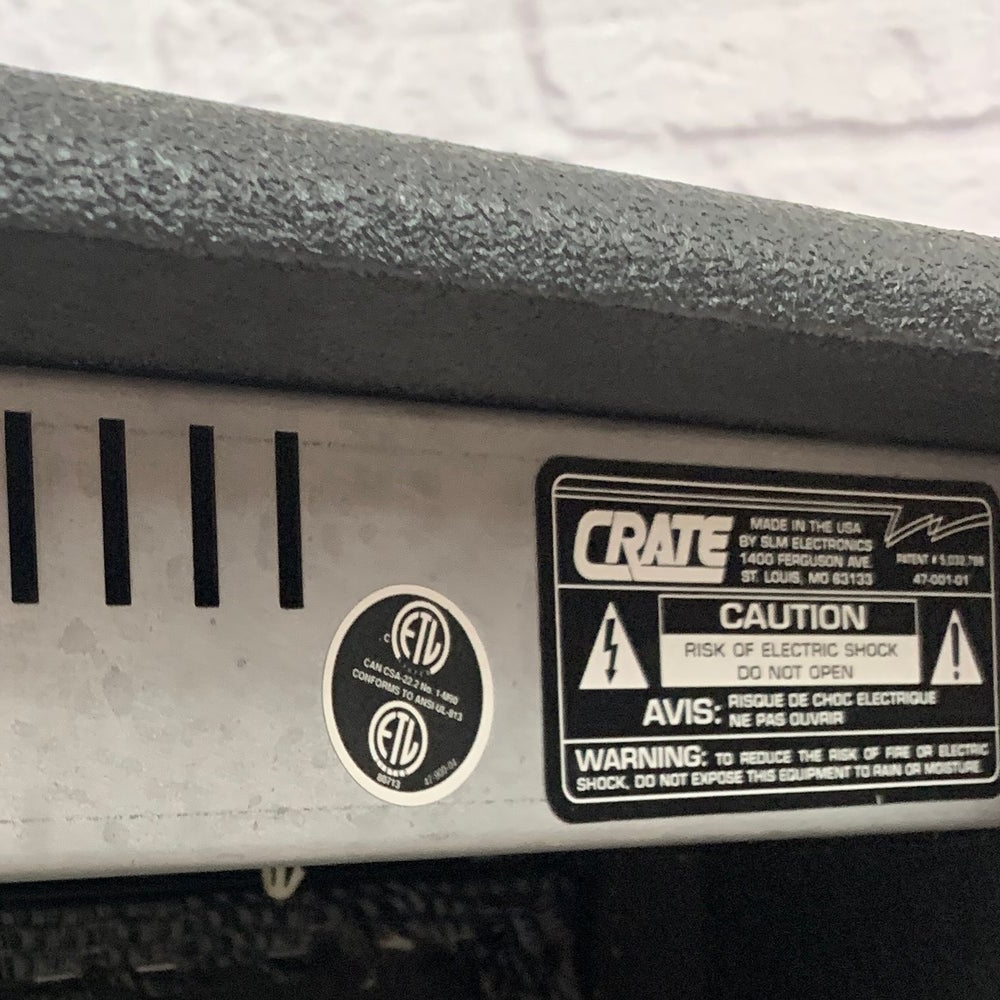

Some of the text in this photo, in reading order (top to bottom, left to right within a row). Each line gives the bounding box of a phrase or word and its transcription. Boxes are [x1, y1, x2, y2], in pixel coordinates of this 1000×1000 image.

[750, 517, 862, 534] MADE IN THE USA
[572, 508, 735, 584] CRATE
[739, 535, 873, 552] BY SLM ELECTRONICS
[739, 552, 774, 565] 1400
[778, 554, 844, 568] FERGUSON
[896, 553, 930, 565] PATENT
[808, 572, 829, 584] MO
[832, 572, 873, 586] 63133
[719, 602, 868, 631] CAUTION
[684, 642, 898, 658] RISK OF ELECTRIC SHOCK
[737, 665, 853, 680] DO NOT OPEN
[352, 668, 401, 696] CONFORMS
[402, 688, 414, 701] TO
[728, 691, 937, 708] RISQUE DE CHOC ELECTRIQUE
[642, 697, 723, 726] AVIS:
[729, 711, 844, 728] NE PAS OUVRIR
[574, 743, 989, 772] WARNING: TO REDUCE THE RISK OF FIRE OR ELECTRIC
[634, 774, 655, 788] DO
[659, 773, 688, 787] NOT
[691, 770, 744, 786] EXPOSE
[746, 768, 776, 784] THIS
[779, 766, 851, 782] EQUIPMENT
[854, 764, 871, 778] TO
[873, 762, 902, 777] RAIN
[905, 761, 921, 776] OR
